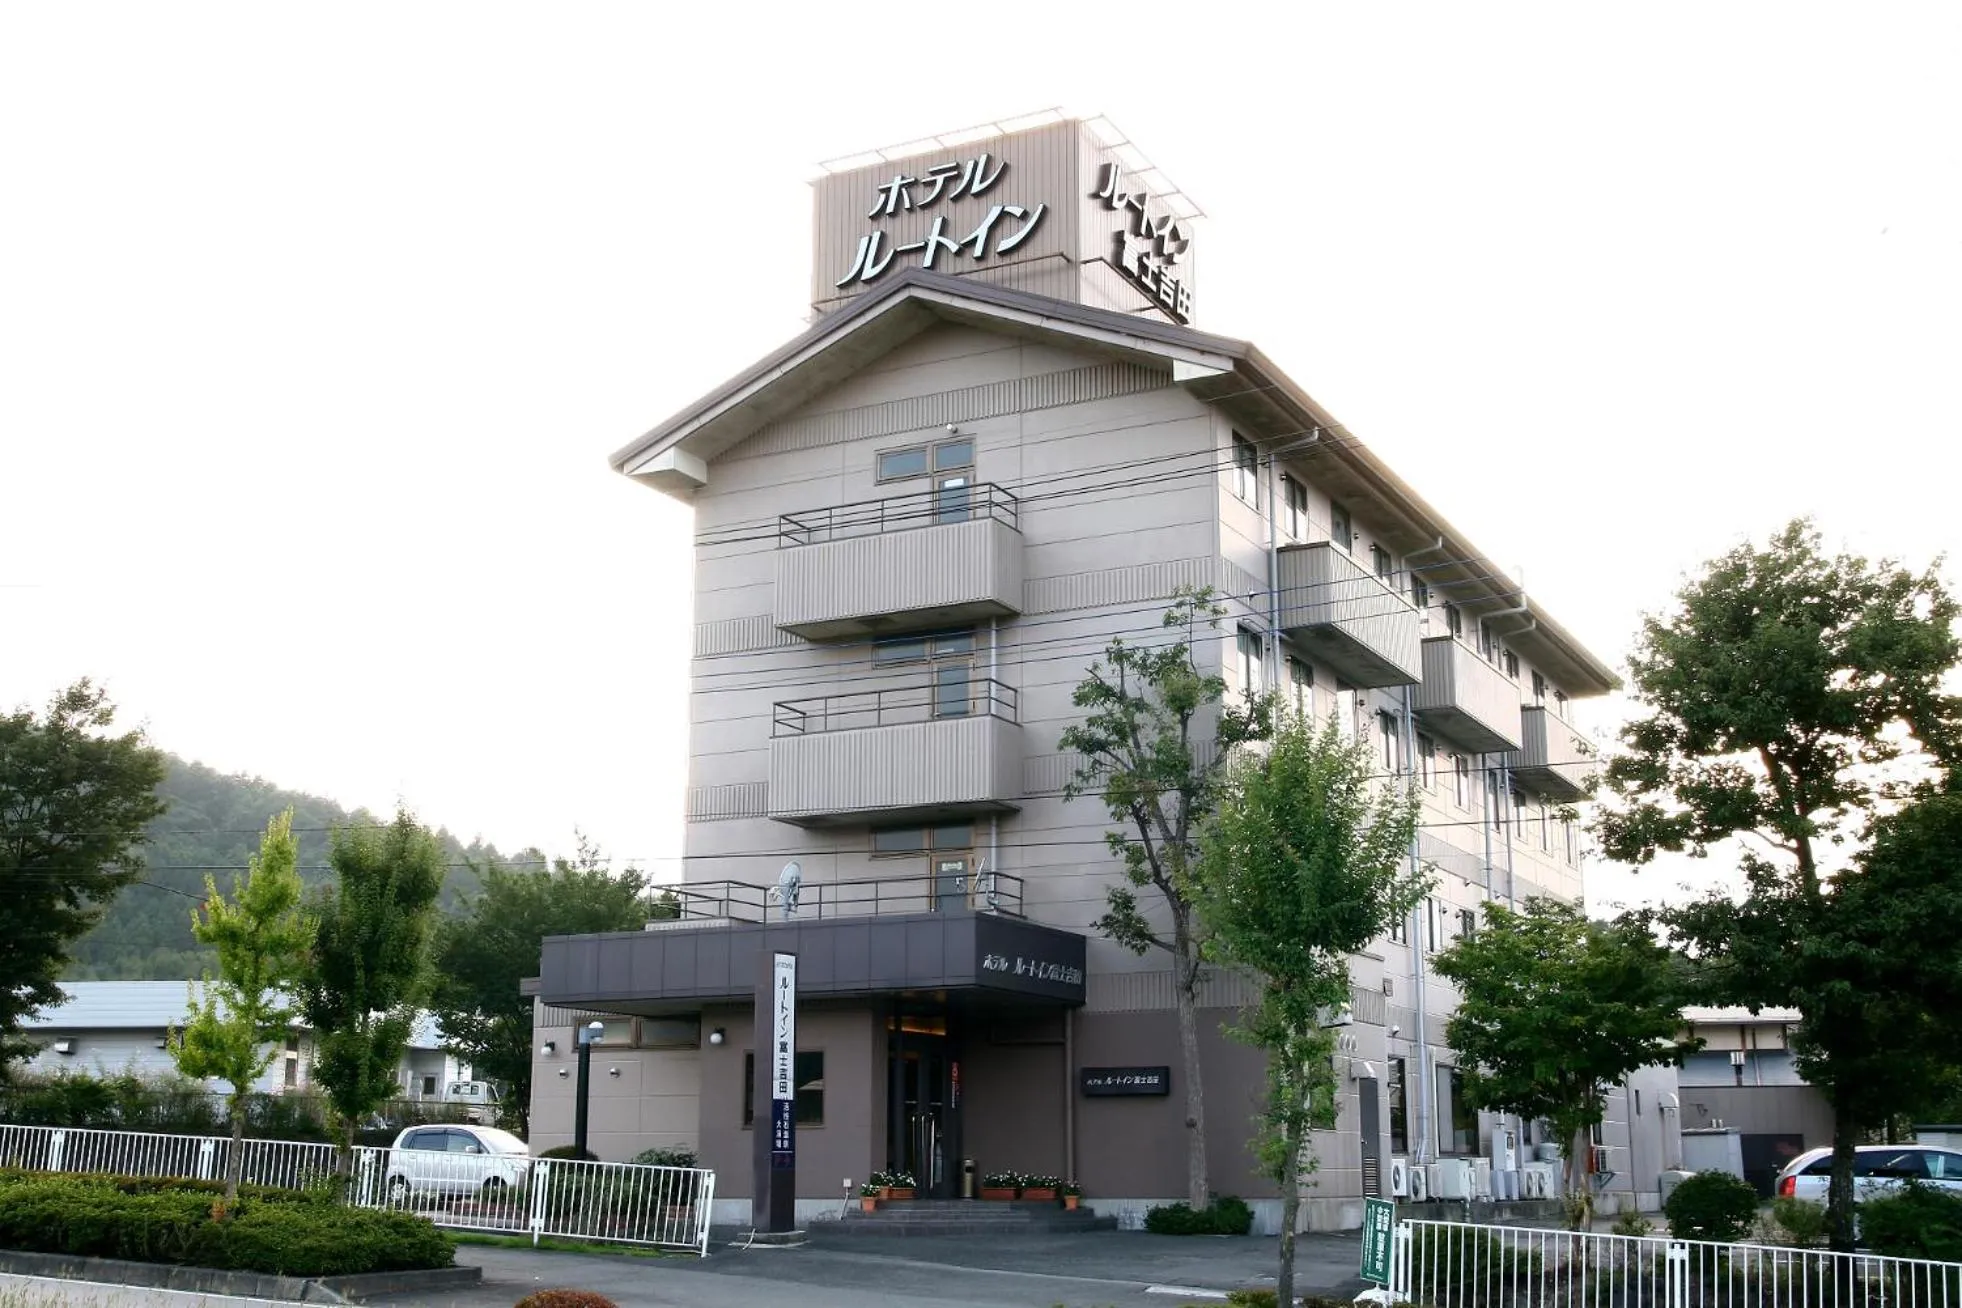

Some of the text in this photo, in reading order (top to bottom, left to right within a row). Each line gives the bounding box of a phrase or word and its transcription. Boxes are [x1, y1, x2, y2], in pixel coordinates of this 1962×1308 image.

[869, 153, 1008, 218] ホテル
[1098, 161, 1189, 264] ルートイン
[836, 202, 1047, 287] ルートイン
